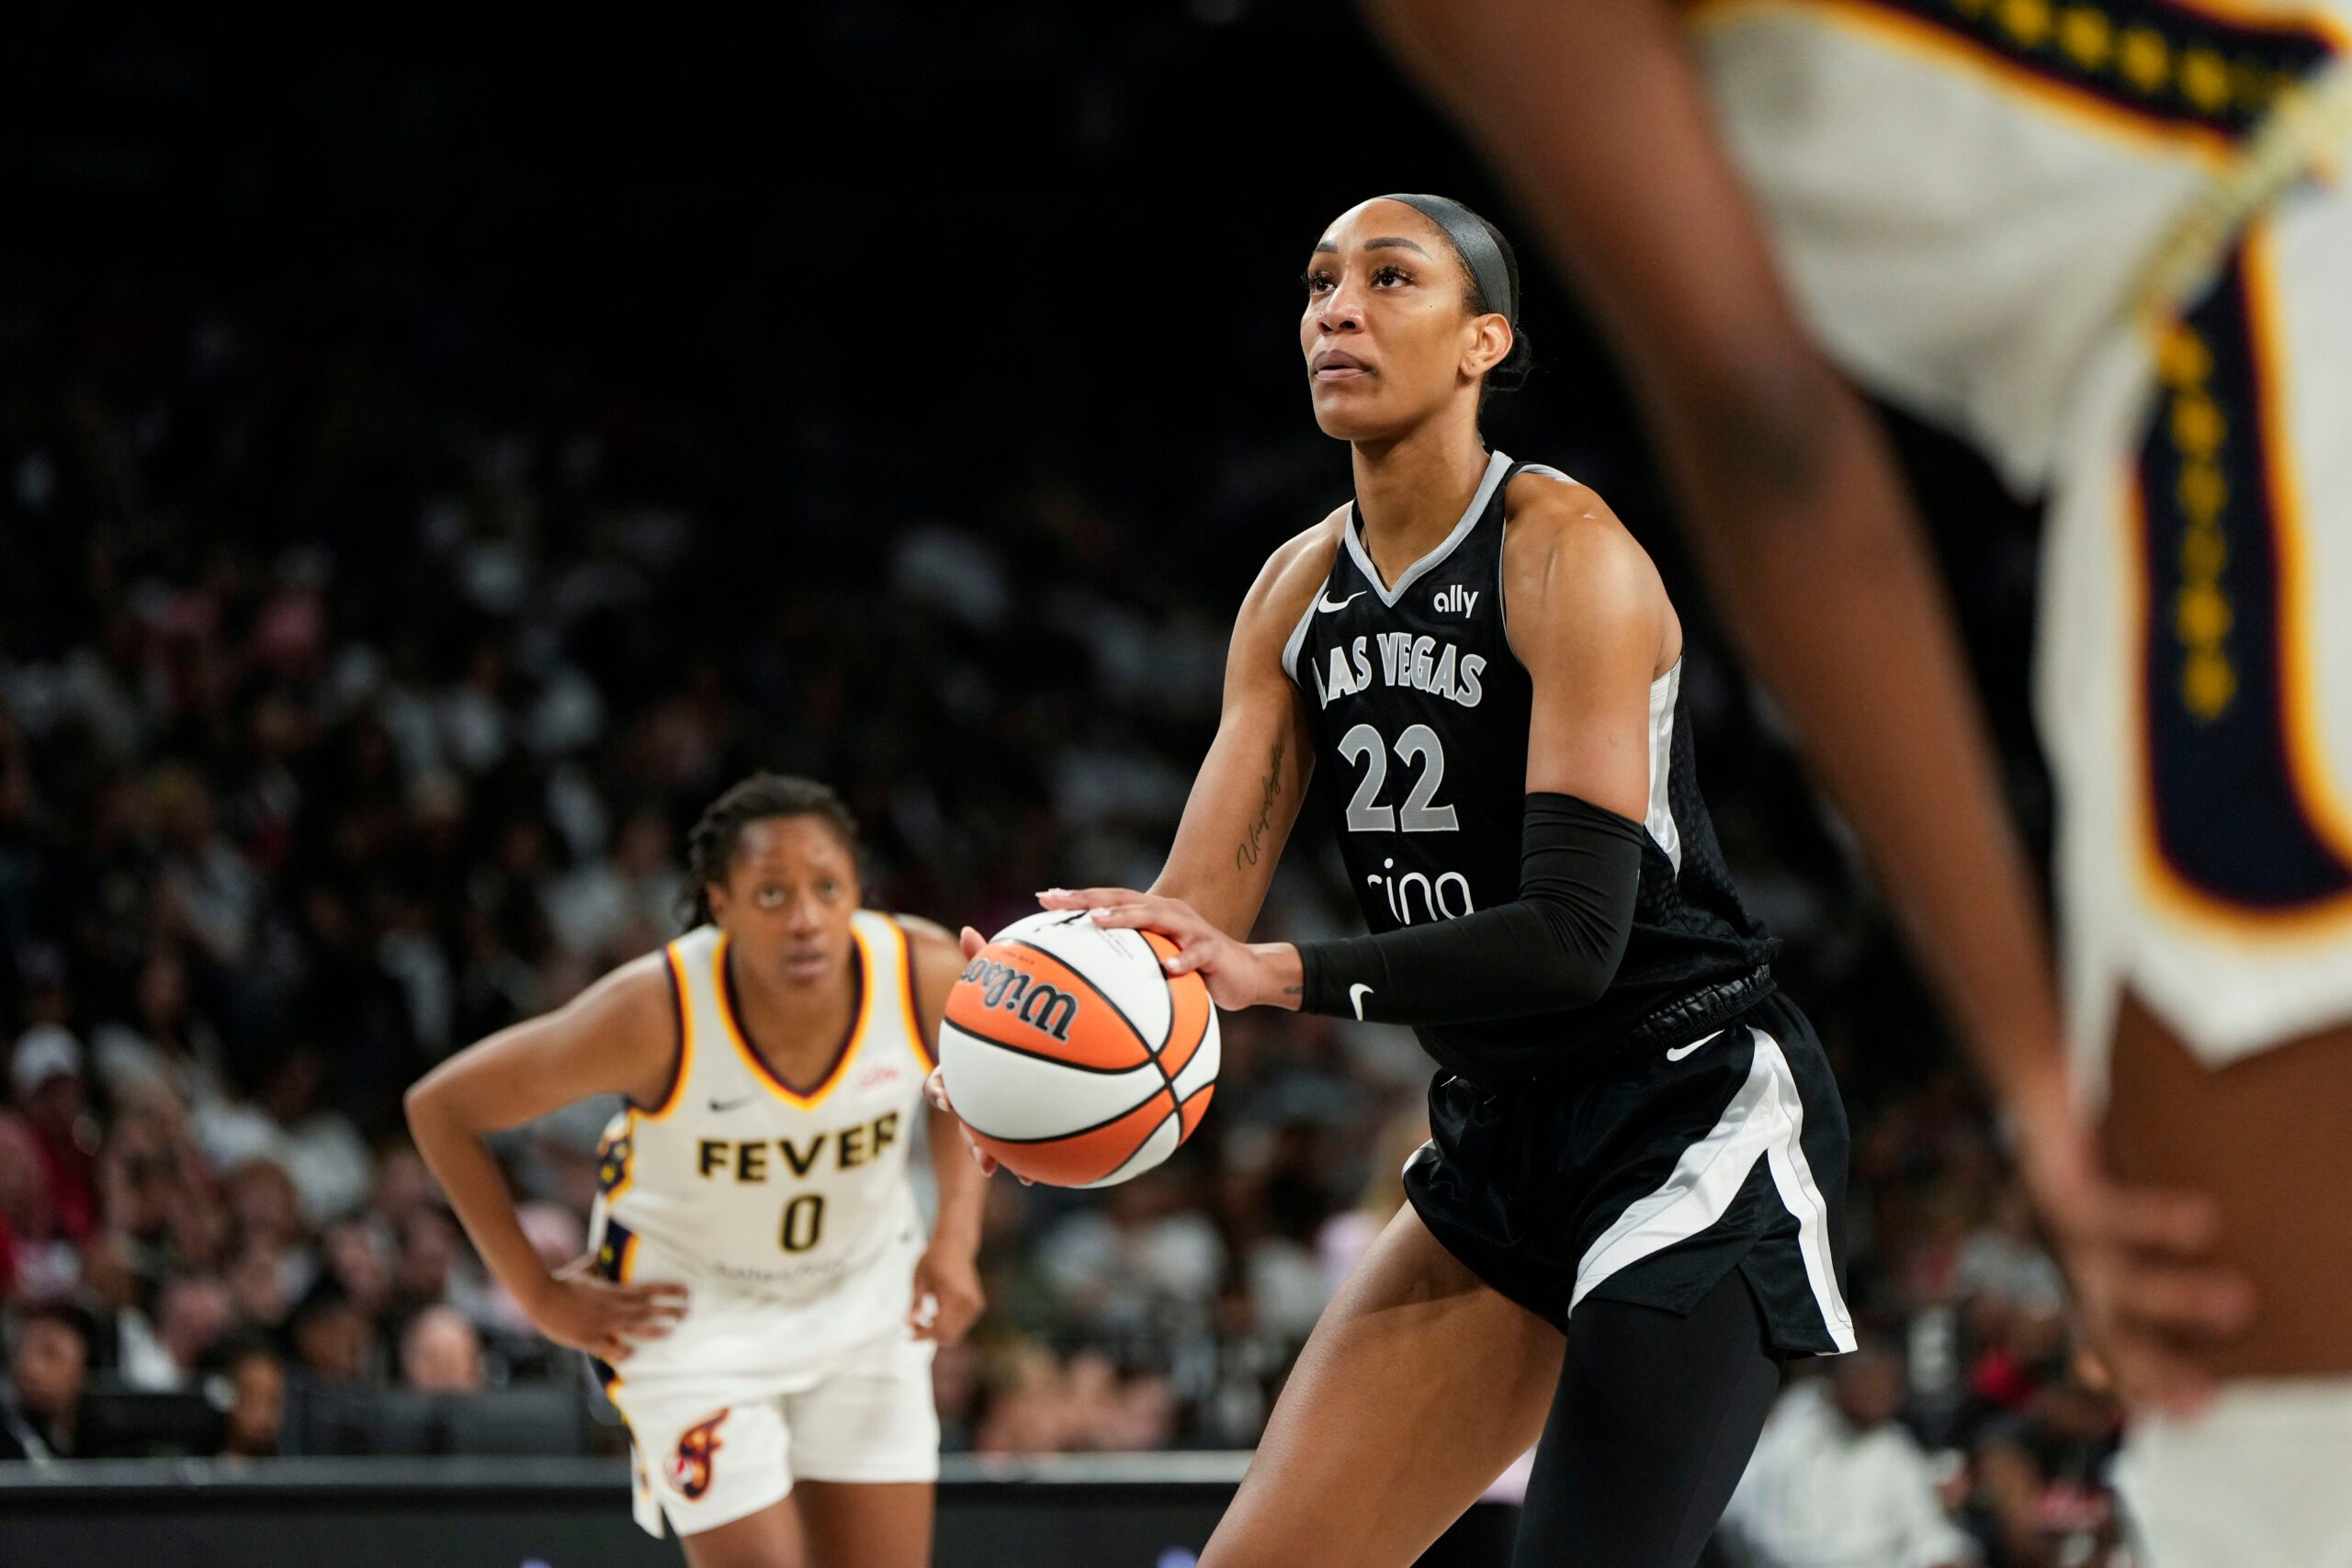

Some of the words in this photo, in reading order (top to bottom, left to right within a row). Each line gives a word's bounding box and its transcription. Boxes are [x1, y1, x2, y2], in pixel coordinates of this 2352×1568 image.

[1433, 584, 1479, 618] ally
[1312, 636, 1373, 711] LAS
[1376, 632, 1487, 707] VEGAS
[1338, 723, 1460, 832] 22
[961, 957, 1080, 1043] Wilso
[779, 1193, 825, 1255] 0
